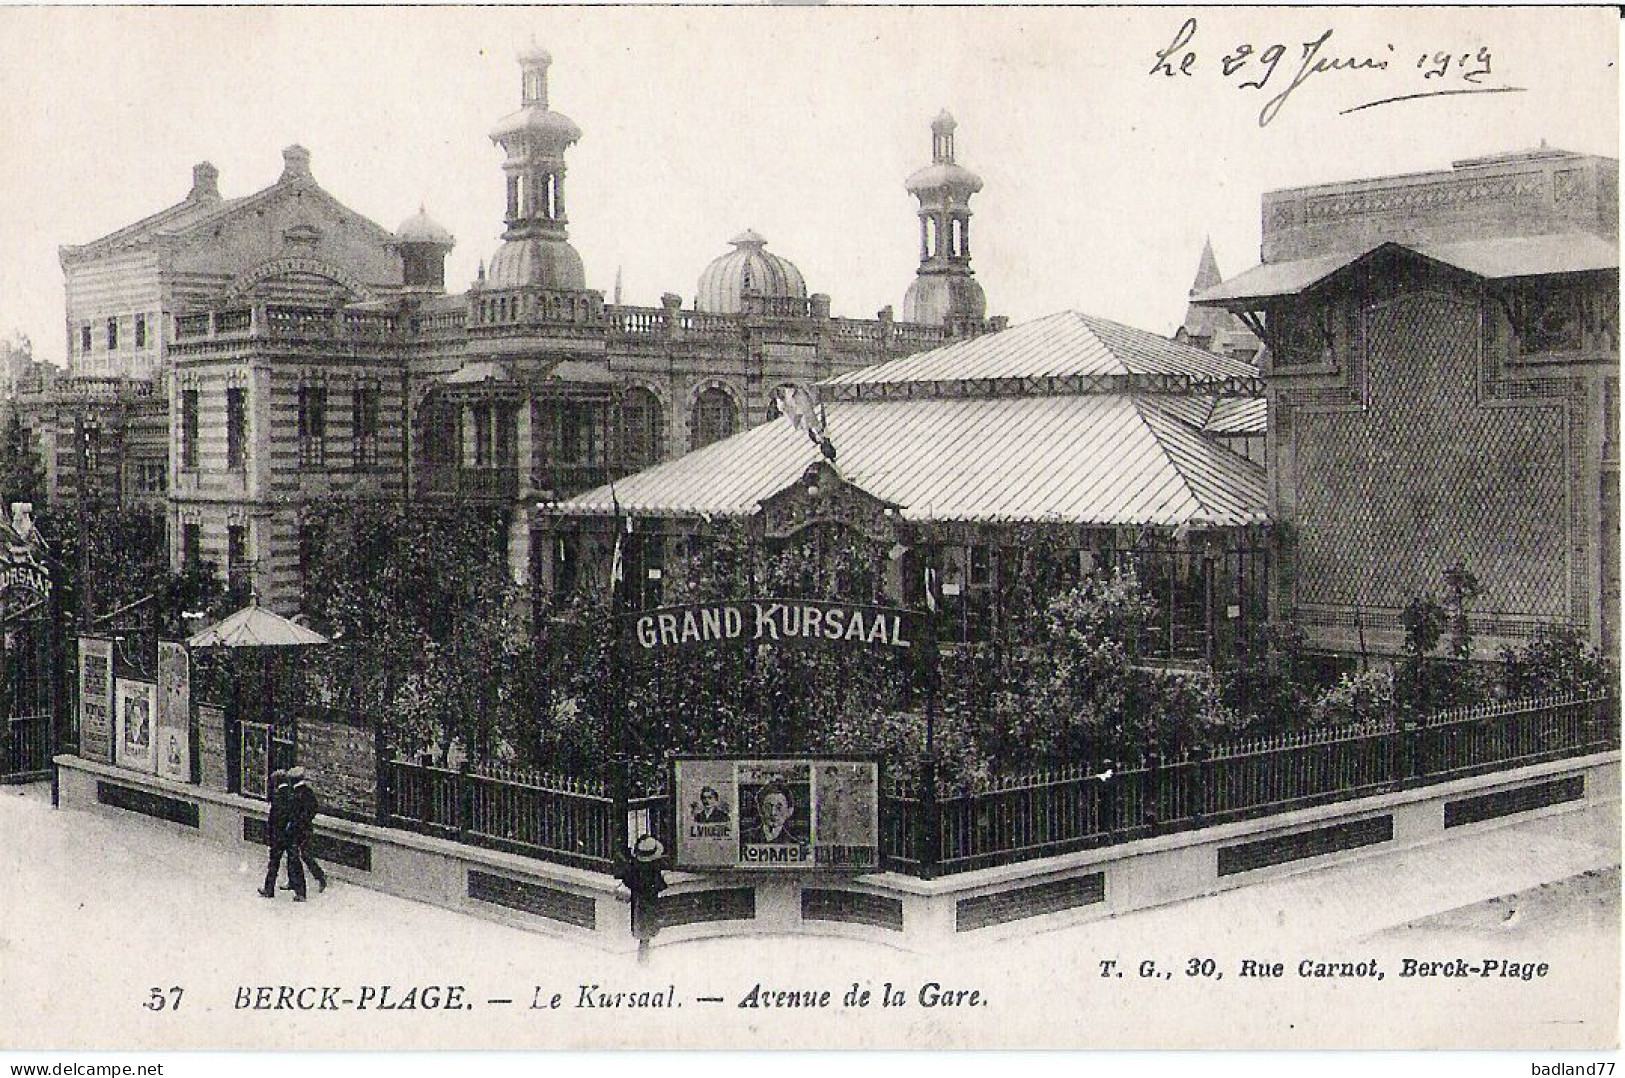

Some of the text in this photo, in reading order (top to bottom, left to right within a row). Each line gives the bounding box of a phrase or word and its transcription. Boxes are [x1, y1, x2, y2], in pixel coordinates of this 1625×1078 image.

[1149, 17, 1197, 77] Le
[1222, 44, 1285, 90] 29
[636, 602, 911, 649] GRAND KURSAAL
